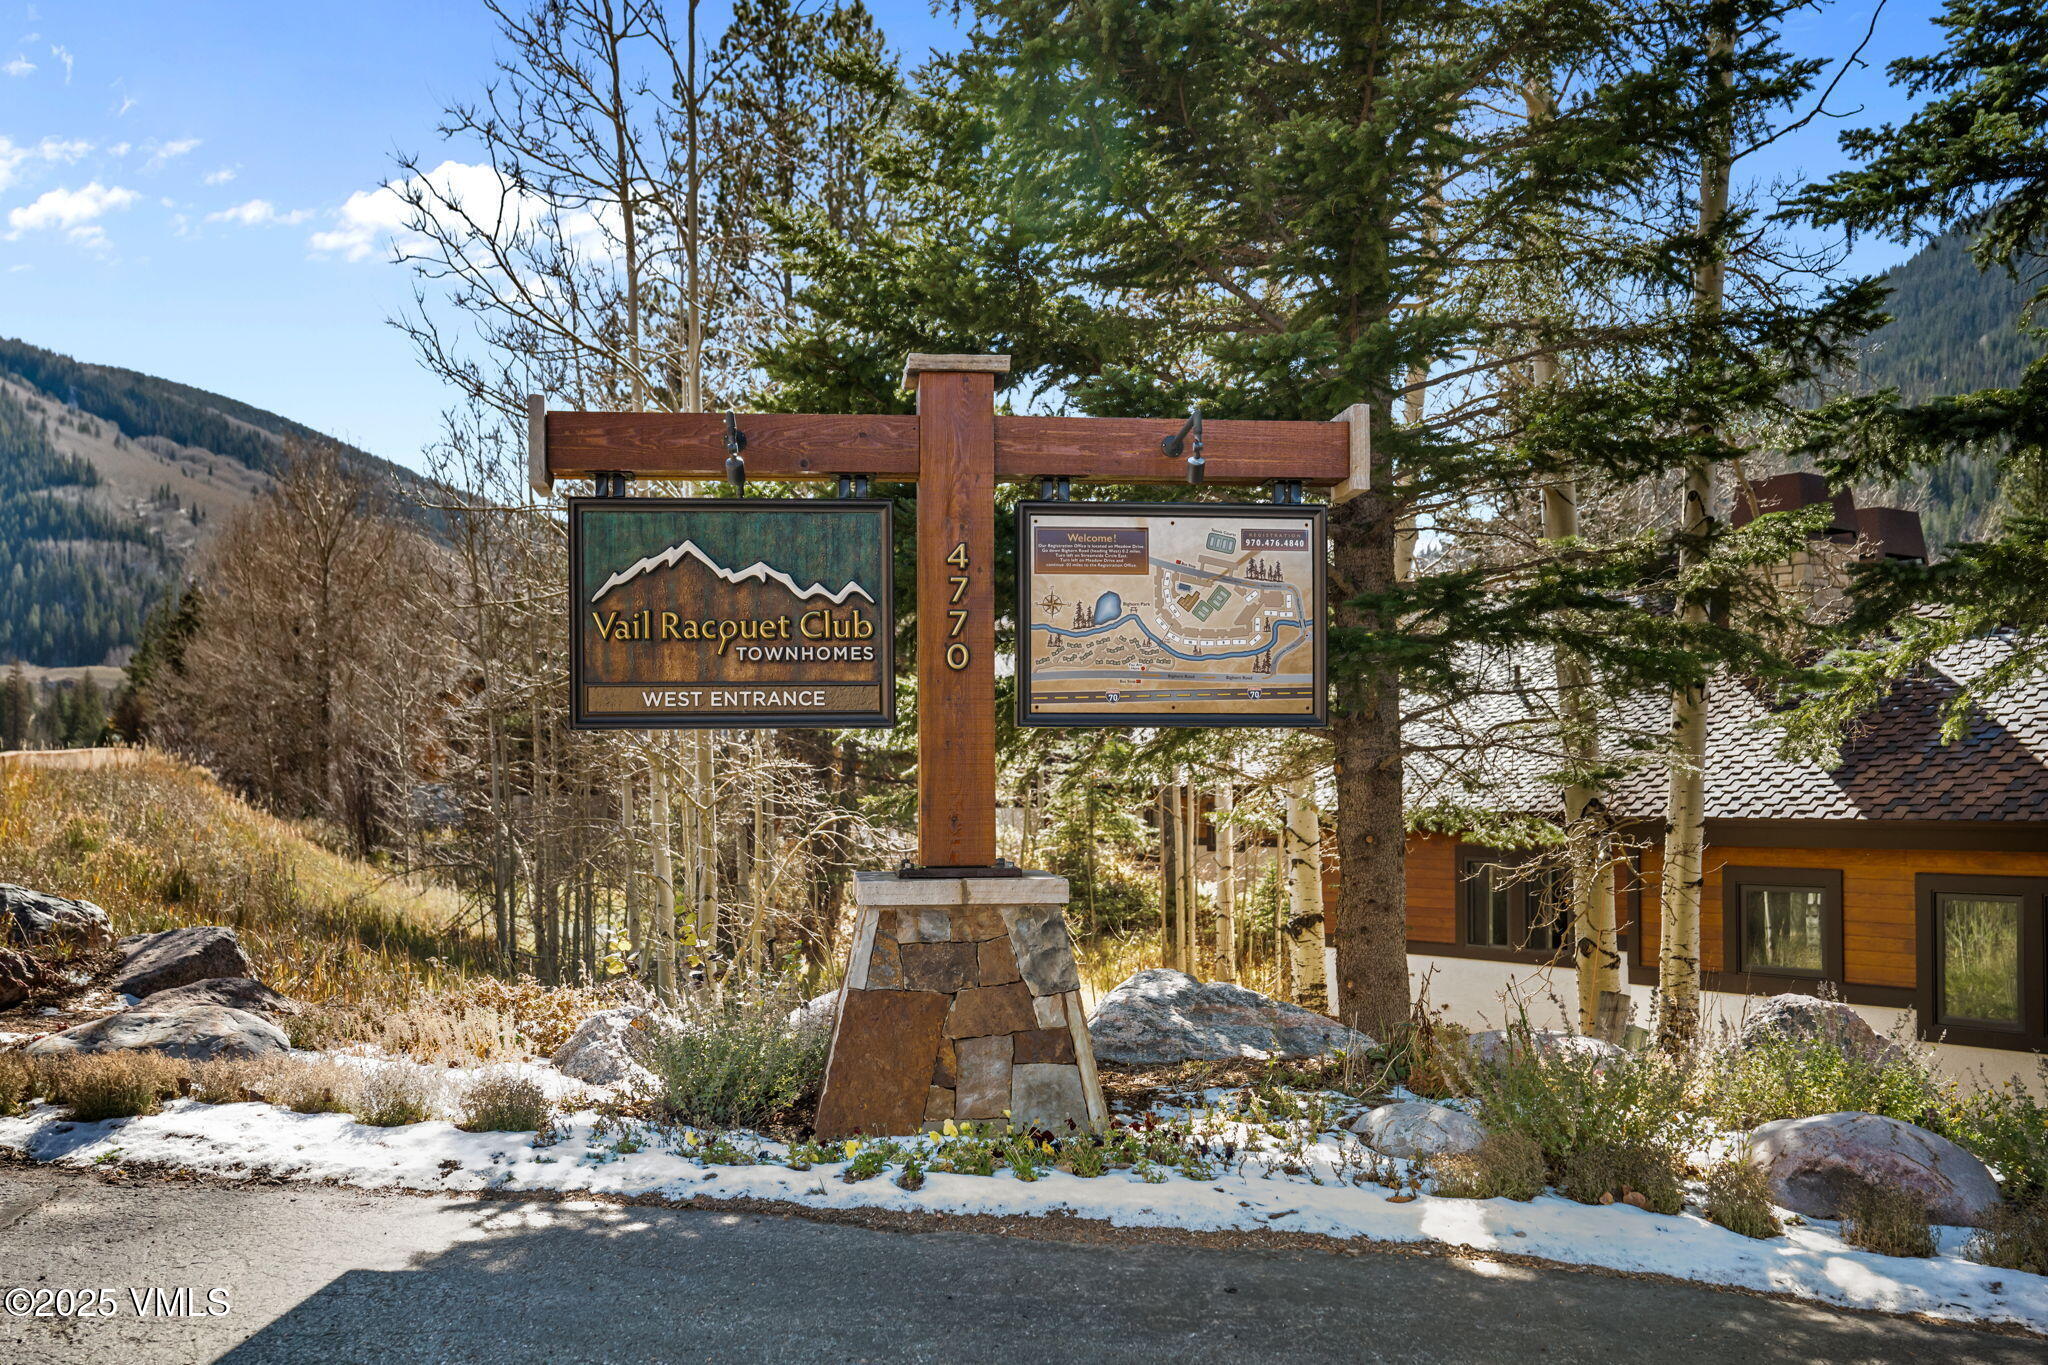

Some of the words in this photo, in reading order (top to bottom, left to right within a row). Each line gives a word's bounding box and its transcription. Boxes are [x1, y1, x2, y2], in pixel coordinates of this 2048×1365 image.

[1068, 533, 1116, 542] Welcome!
[1246, 539, 1304, 547] 970.476.4840
[947, 543, 969, 670] 4770
[592, 610, 650, 640] Vail
[662, 611, 790, 656] Racquet
[800, 610, 874, 640] Club
[736, 646, 874, 661] TOWNHOMES
[642, 691, 703, 707] WEST
[710, 690, 826, 706] ENTRANCE
